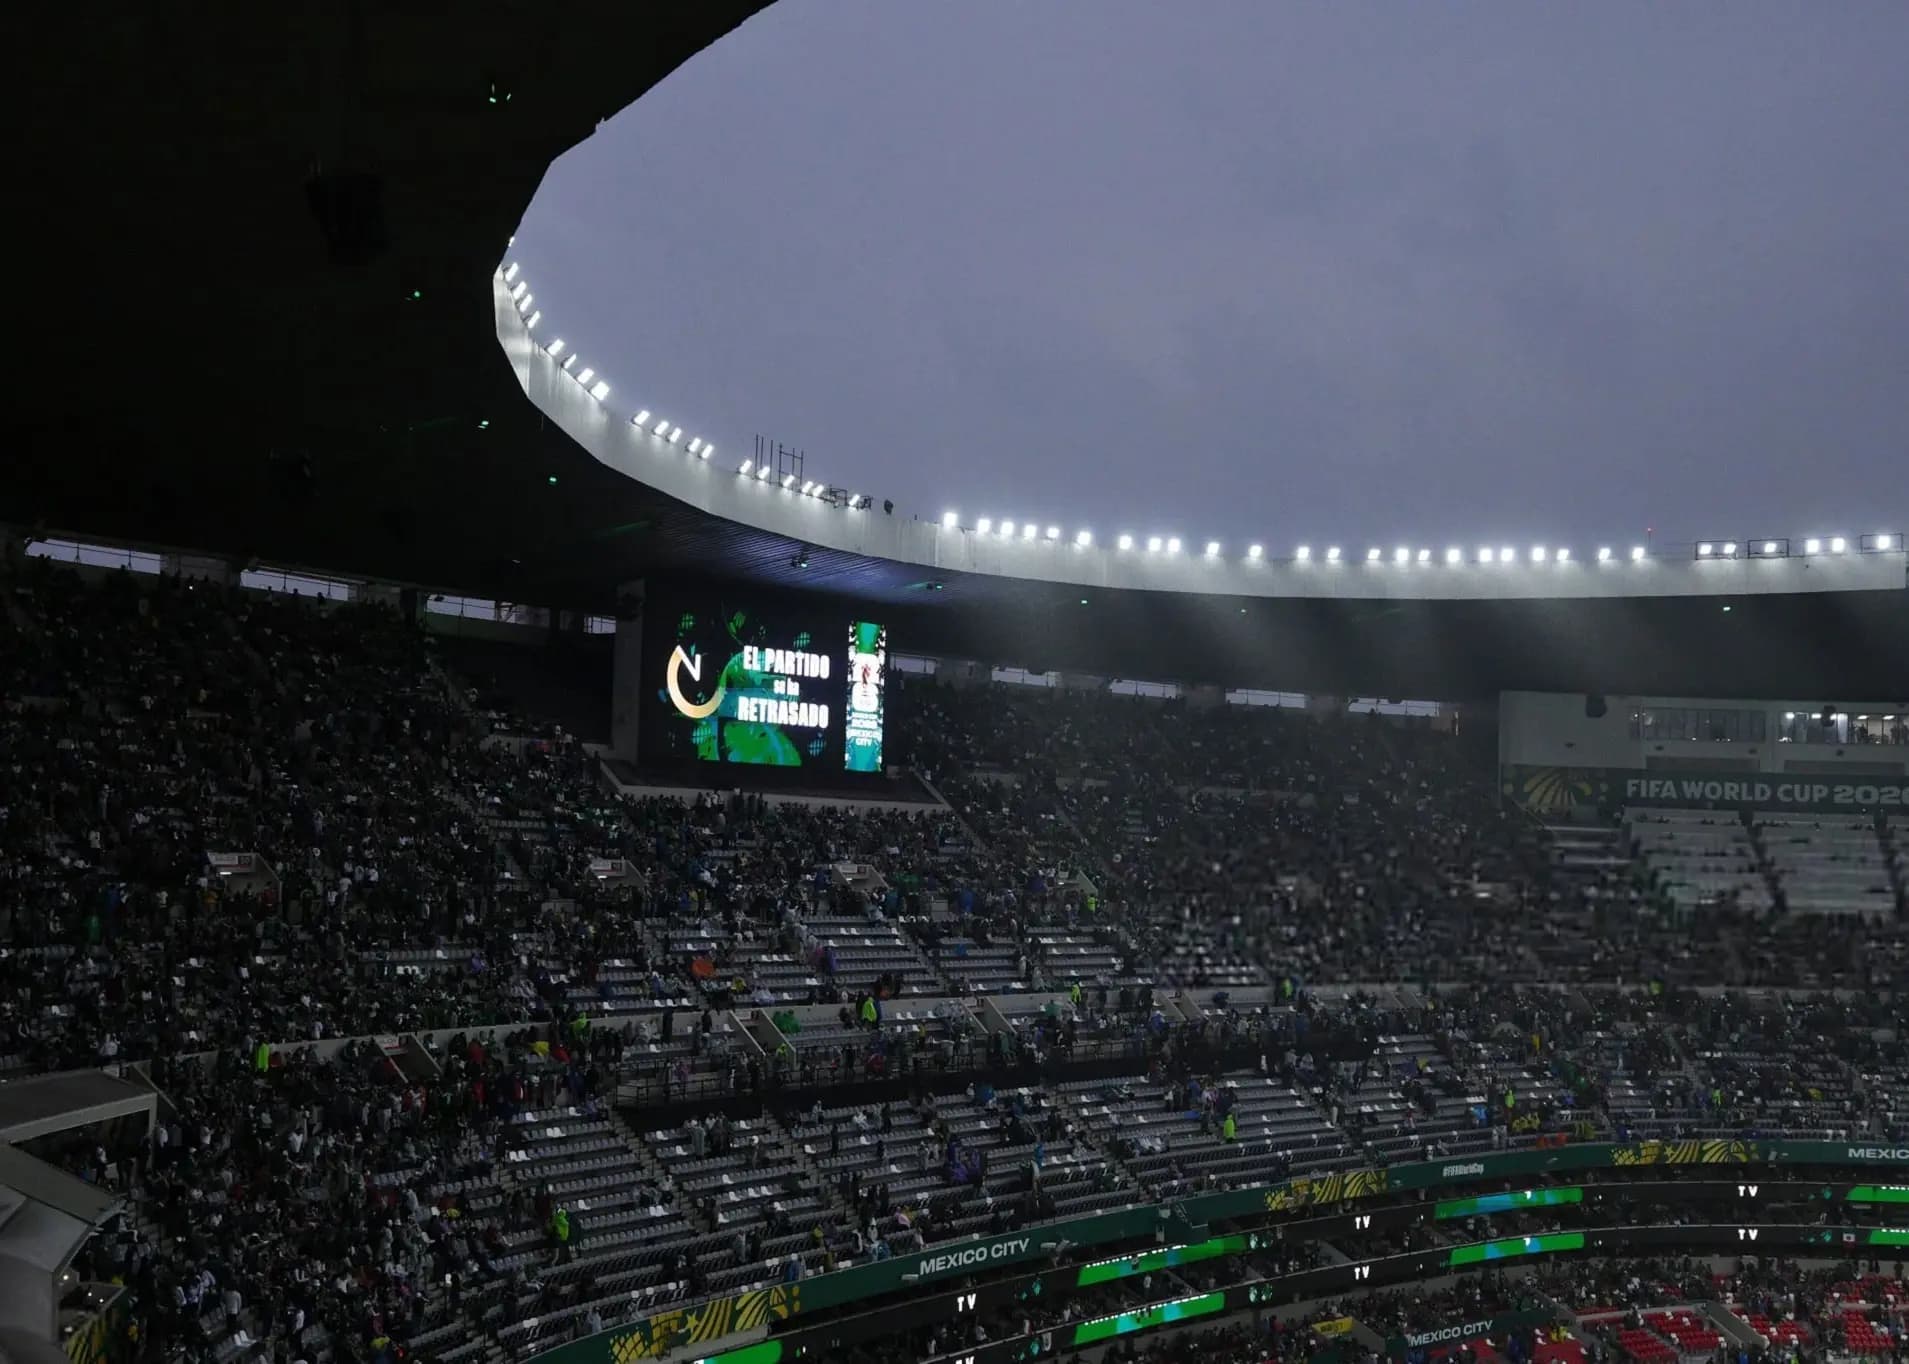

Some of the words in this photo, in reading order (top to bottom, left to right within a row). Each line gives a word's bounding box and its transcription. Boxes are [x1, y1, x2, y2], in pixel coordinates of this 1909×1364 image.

[743, 645, 761, 671] EL
[765, 648, 830, 679] PARTIDO
[774, 680, 786, 695] se
[787, 677, 800, 696] ha
[738, 696, 829, 729] RETRASADO
[1626, 779, 1678, 799] FIFA
[1682, 780, 1772, 802] WORLD
[1777, 783, 1829, 803] CUP
[920, 1247, 988, 1275] MEXICO
[991, 1238, 1030, 1259] CITY
[1410, 1326, 1461, 1347] MEXICO
[1463, 1319, 1493, 1336] CITY
